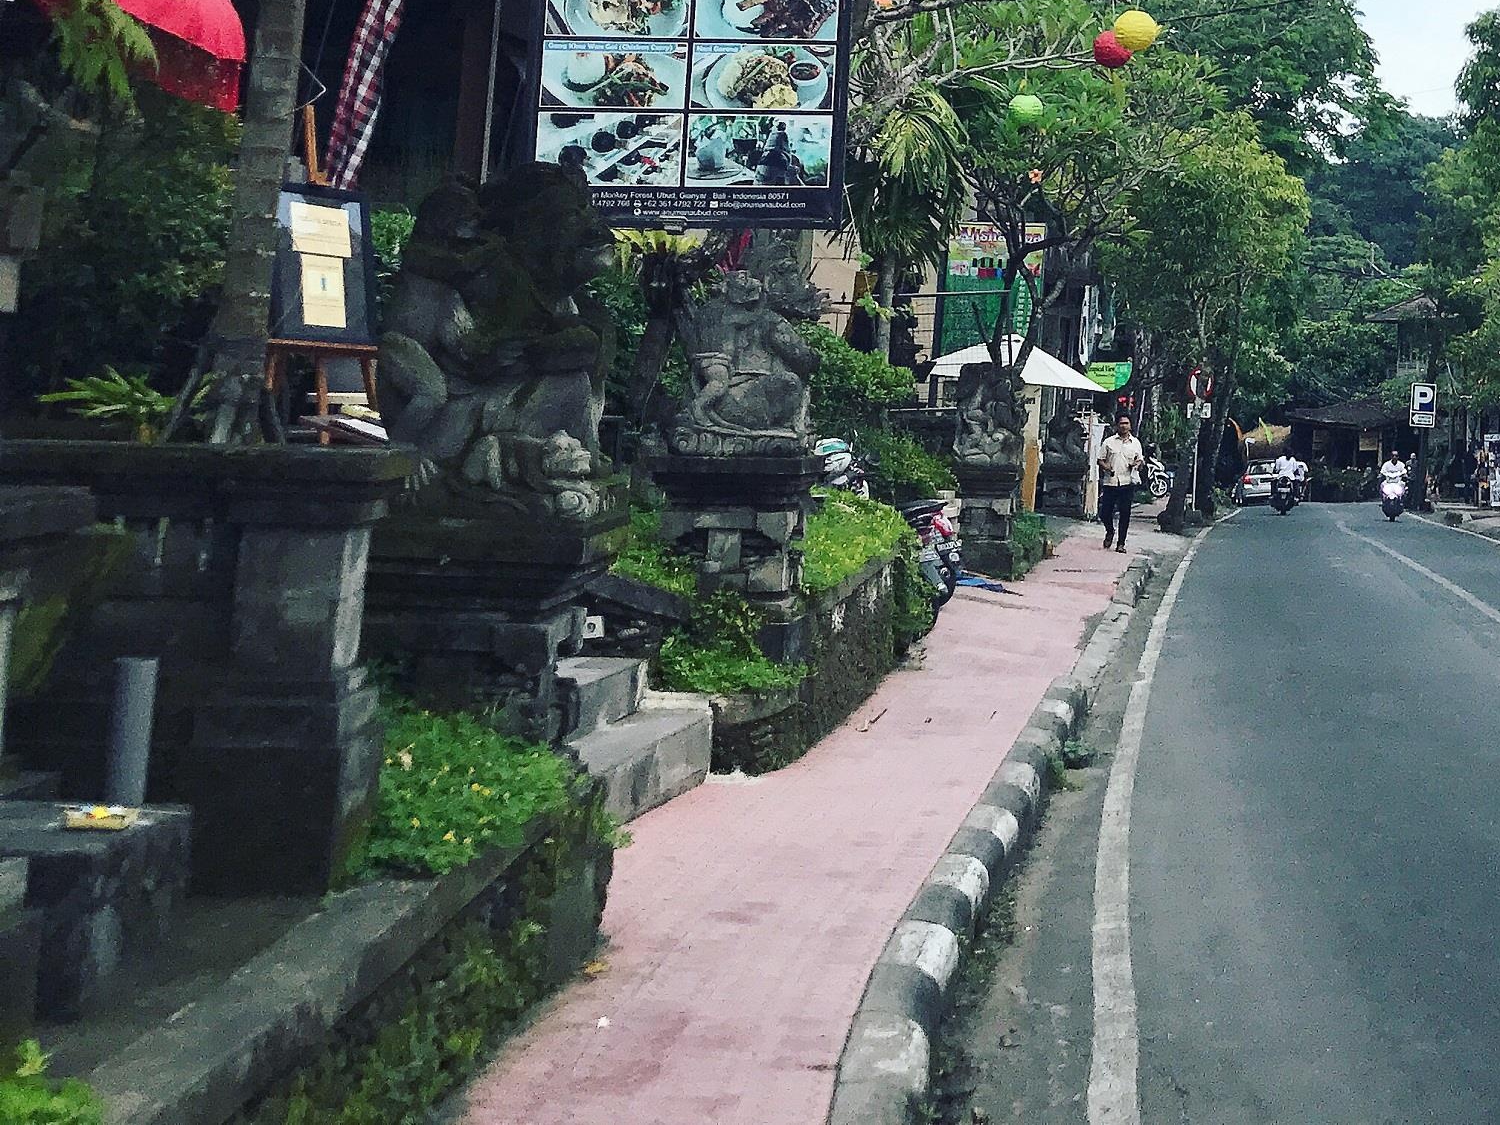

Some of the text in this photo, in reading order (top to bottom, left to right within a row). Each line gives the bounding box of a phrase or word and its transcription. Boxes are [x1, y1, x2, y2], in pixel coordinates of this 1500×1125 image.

[600, 191, 628, 200] Monkey
[630, 191, 655, 199] Forest,
[732, 192, 766, 200] Indonesia
[1414, 386, 1434, 411] P
